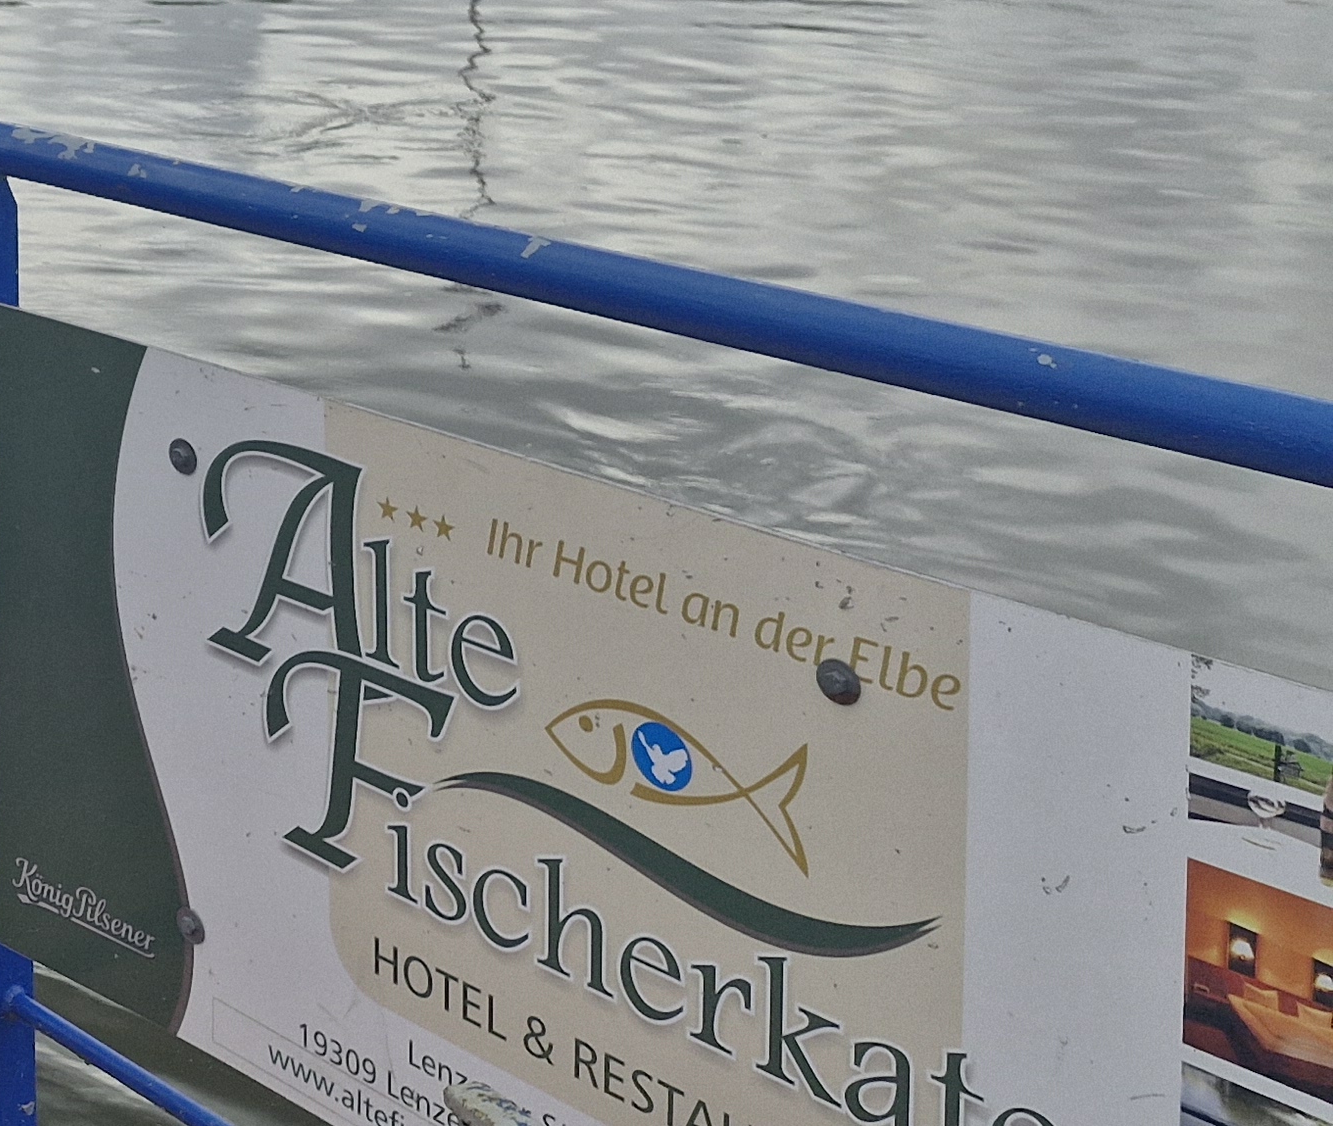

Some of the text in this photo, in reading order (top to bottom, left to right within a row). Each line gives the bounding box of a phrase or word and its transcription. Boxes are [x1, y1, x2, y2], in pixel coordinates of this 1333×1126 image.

[202, 439, 519, 708] Alte
[486, 517, 962, 711] Ihr Hotel an der Elbe
[265, 650, 1055, 1126] Fischerkat
[299, 1023, 464, 1126] 19309 Lenze
[372, 937, 752, 1126] HOTEL & RESTA
